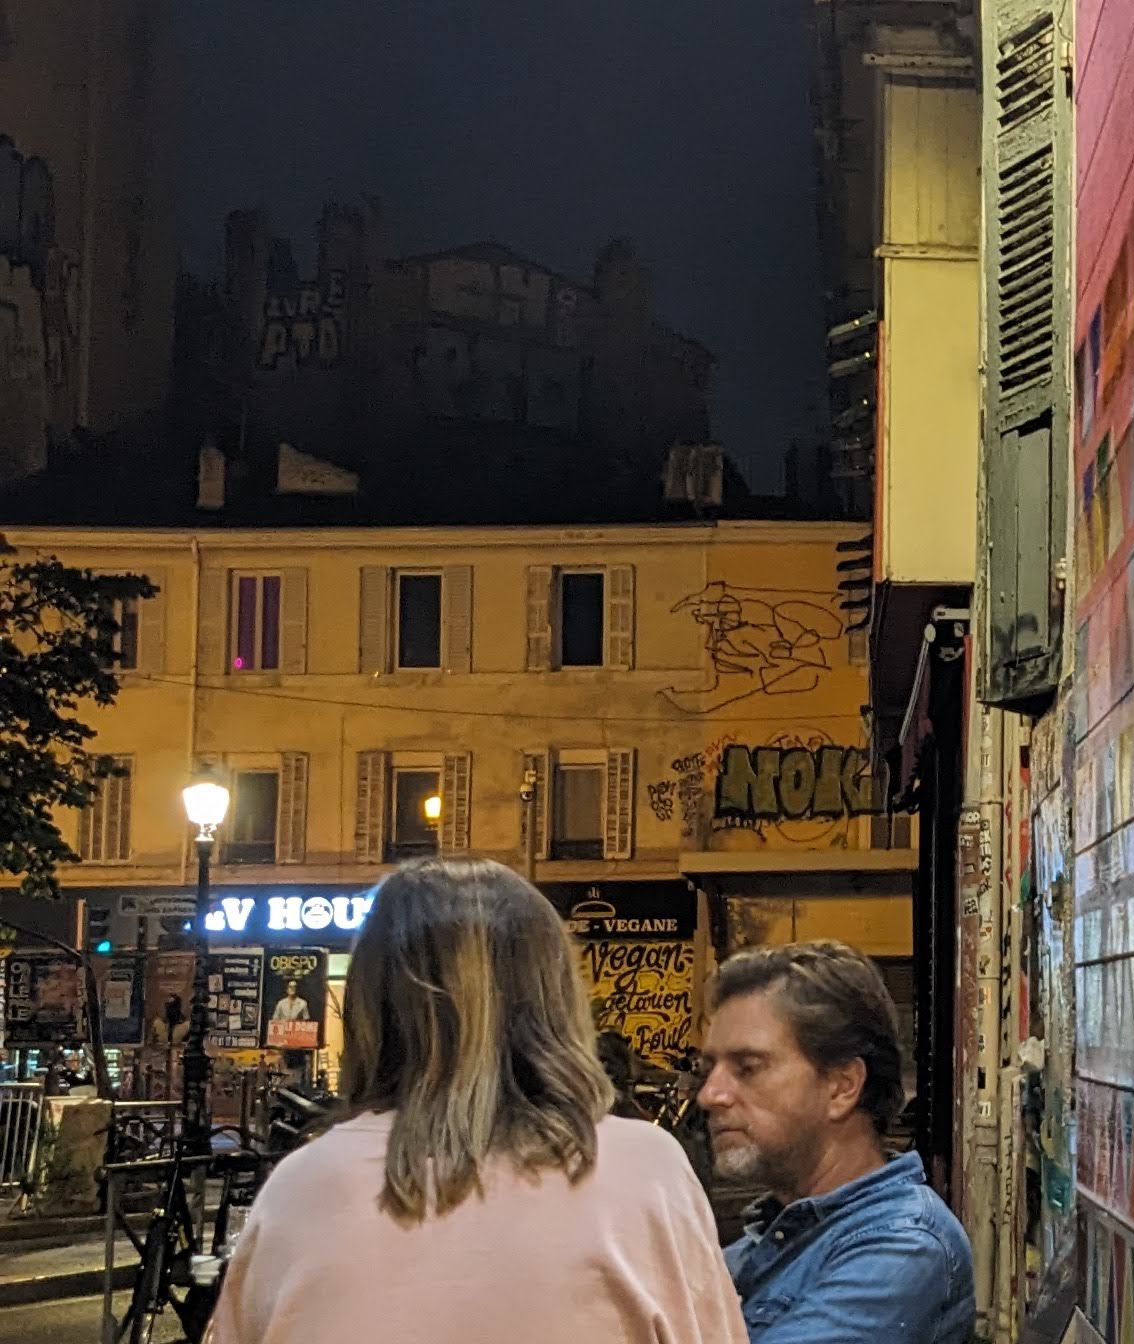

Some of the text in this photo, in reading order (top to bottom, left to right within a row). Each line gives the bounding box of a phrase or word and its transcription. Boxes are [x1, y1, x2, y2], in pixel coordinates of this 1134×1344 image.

[268, 896, 374, 930] HOU
[604, 919, 678, 932] VEGANE
[270, 955, 318, 971] OBISPO
[581, 941, 686, 993] Vegan
